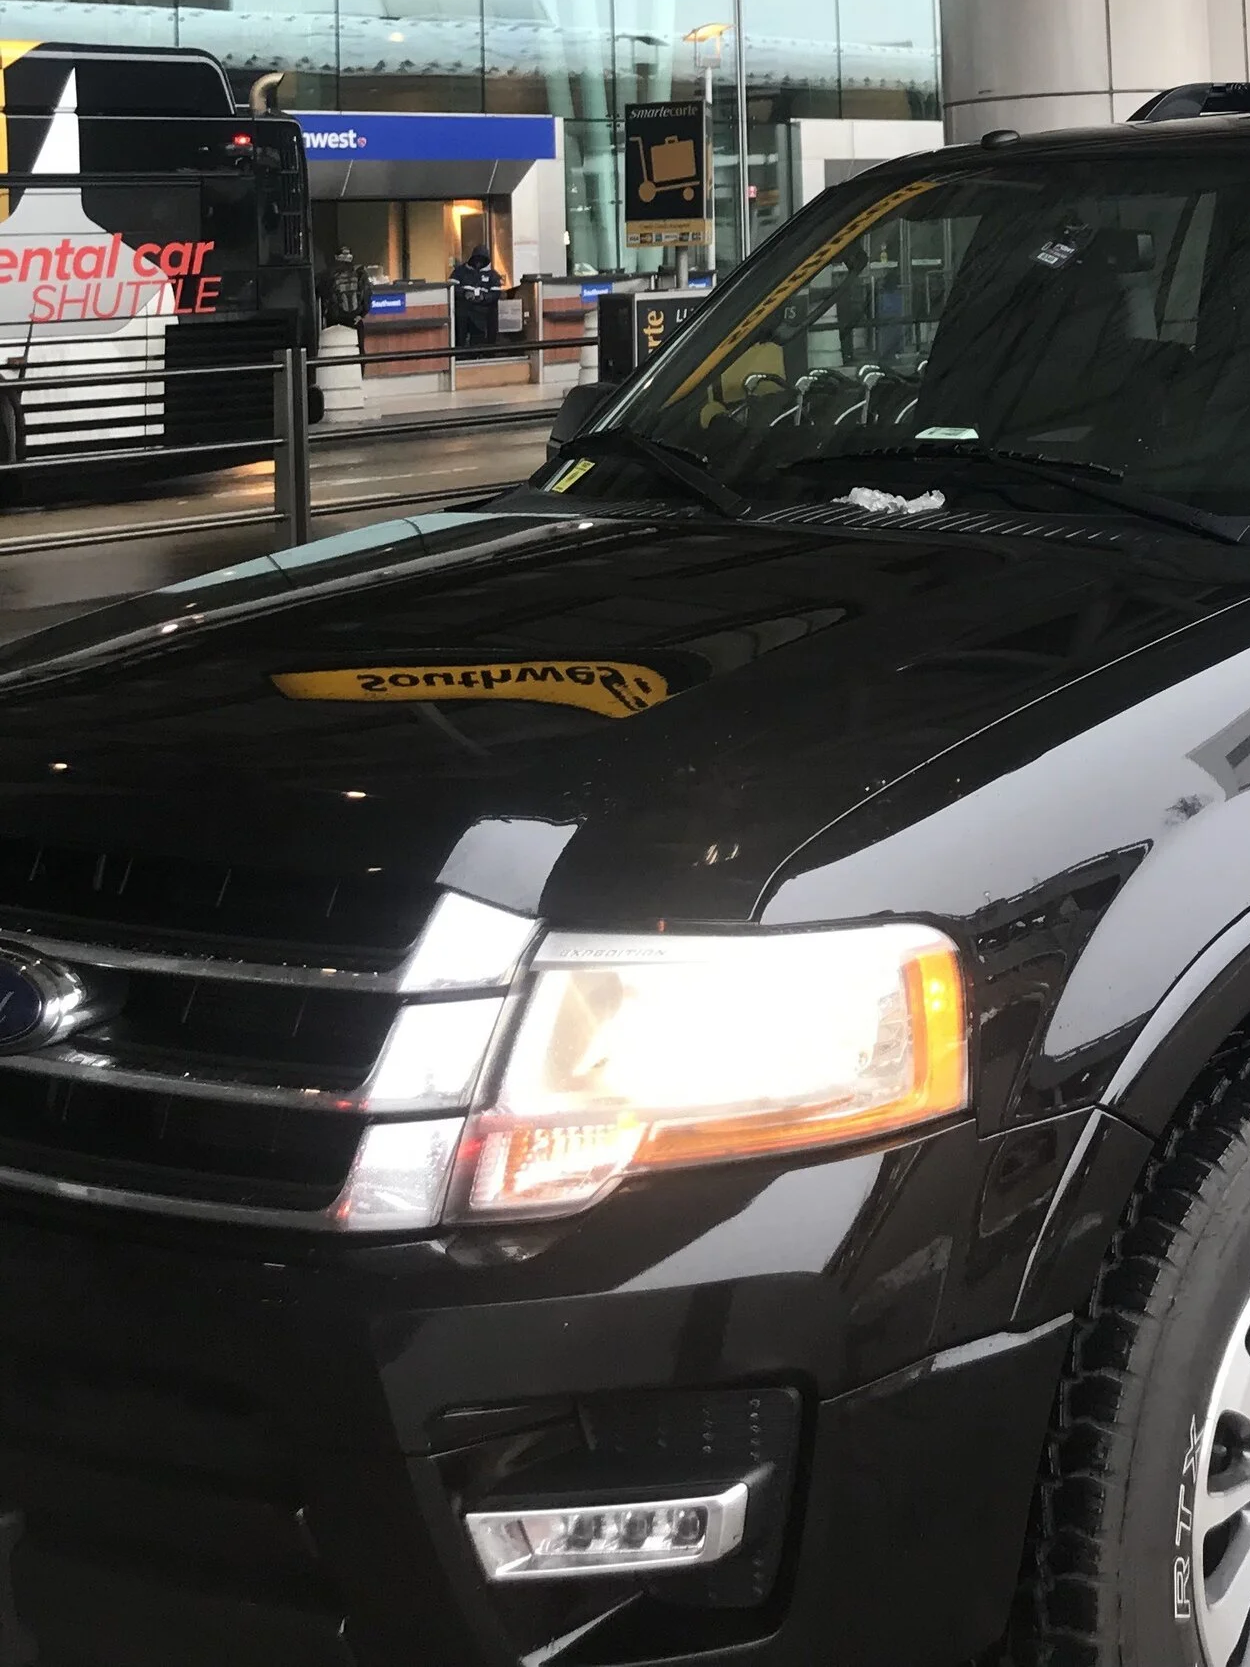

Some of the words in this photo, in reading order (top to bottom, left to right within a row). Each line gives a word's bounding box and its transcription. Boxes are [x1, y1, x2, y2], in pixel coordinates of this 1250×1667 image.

[133, 240, 215, 278] car
[29, 276, 222, 324] SHUTTLE
[1174, 1413, 1205, 1619] RTX
